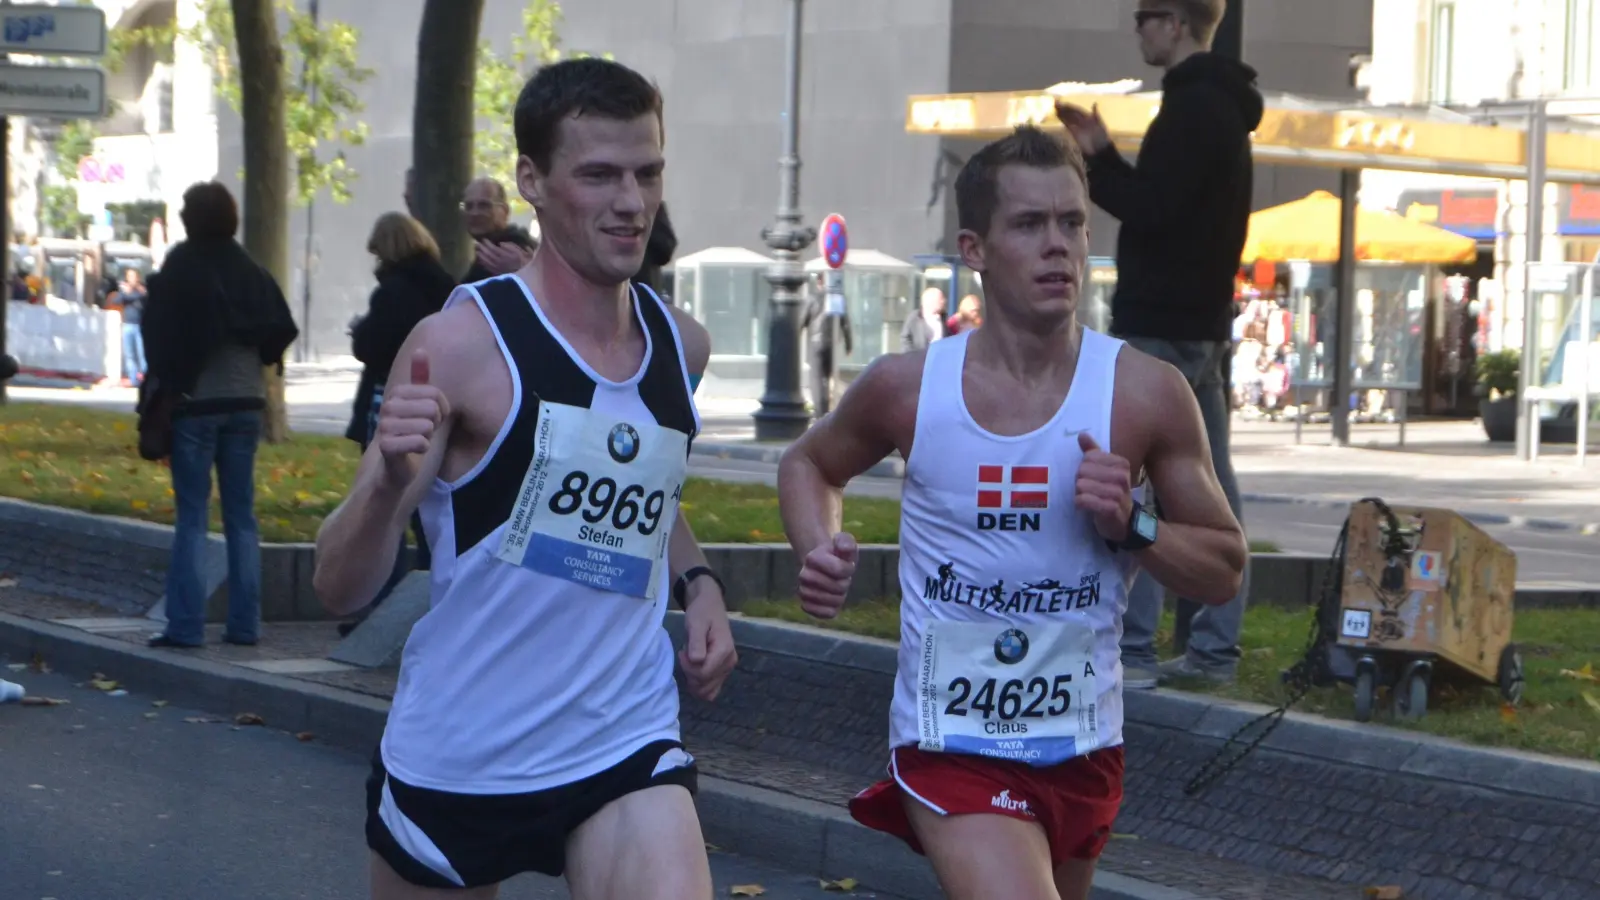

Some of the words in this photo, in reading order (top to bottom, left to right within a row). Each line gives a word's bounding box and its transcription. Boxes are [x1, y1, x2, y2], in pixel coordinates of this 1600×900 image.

[511, 507, 526, 532] BMW
[520, 417, 551, 508] BERLIN-MARATHON
[519, 490, 541, 536] September
[536, 470, 548, 492] 2012
[548, 470, 665, 536] 8969
[977, 513, 1041, 531] DEN
[578, 525, 624, 548] Stefan
[563, 556, 625, 577] CONSULTANCY
[586, 550, 611, 564] TATA
[571, 569, 612, 586] SERVICES
[921, 634, 933, 719] BERLIN-MARATHON
[1083, 661, 1096, 678] A
[944, 674, 1072, 720] 24625
[923, 718, 932, 738] BMW
[931, 702, 941, 739] September
[984, 721, 1028, 735] Claus
[979, 748, 1041, 759] CONSULTANCY
[996, 741, 1025, 750] TATA
